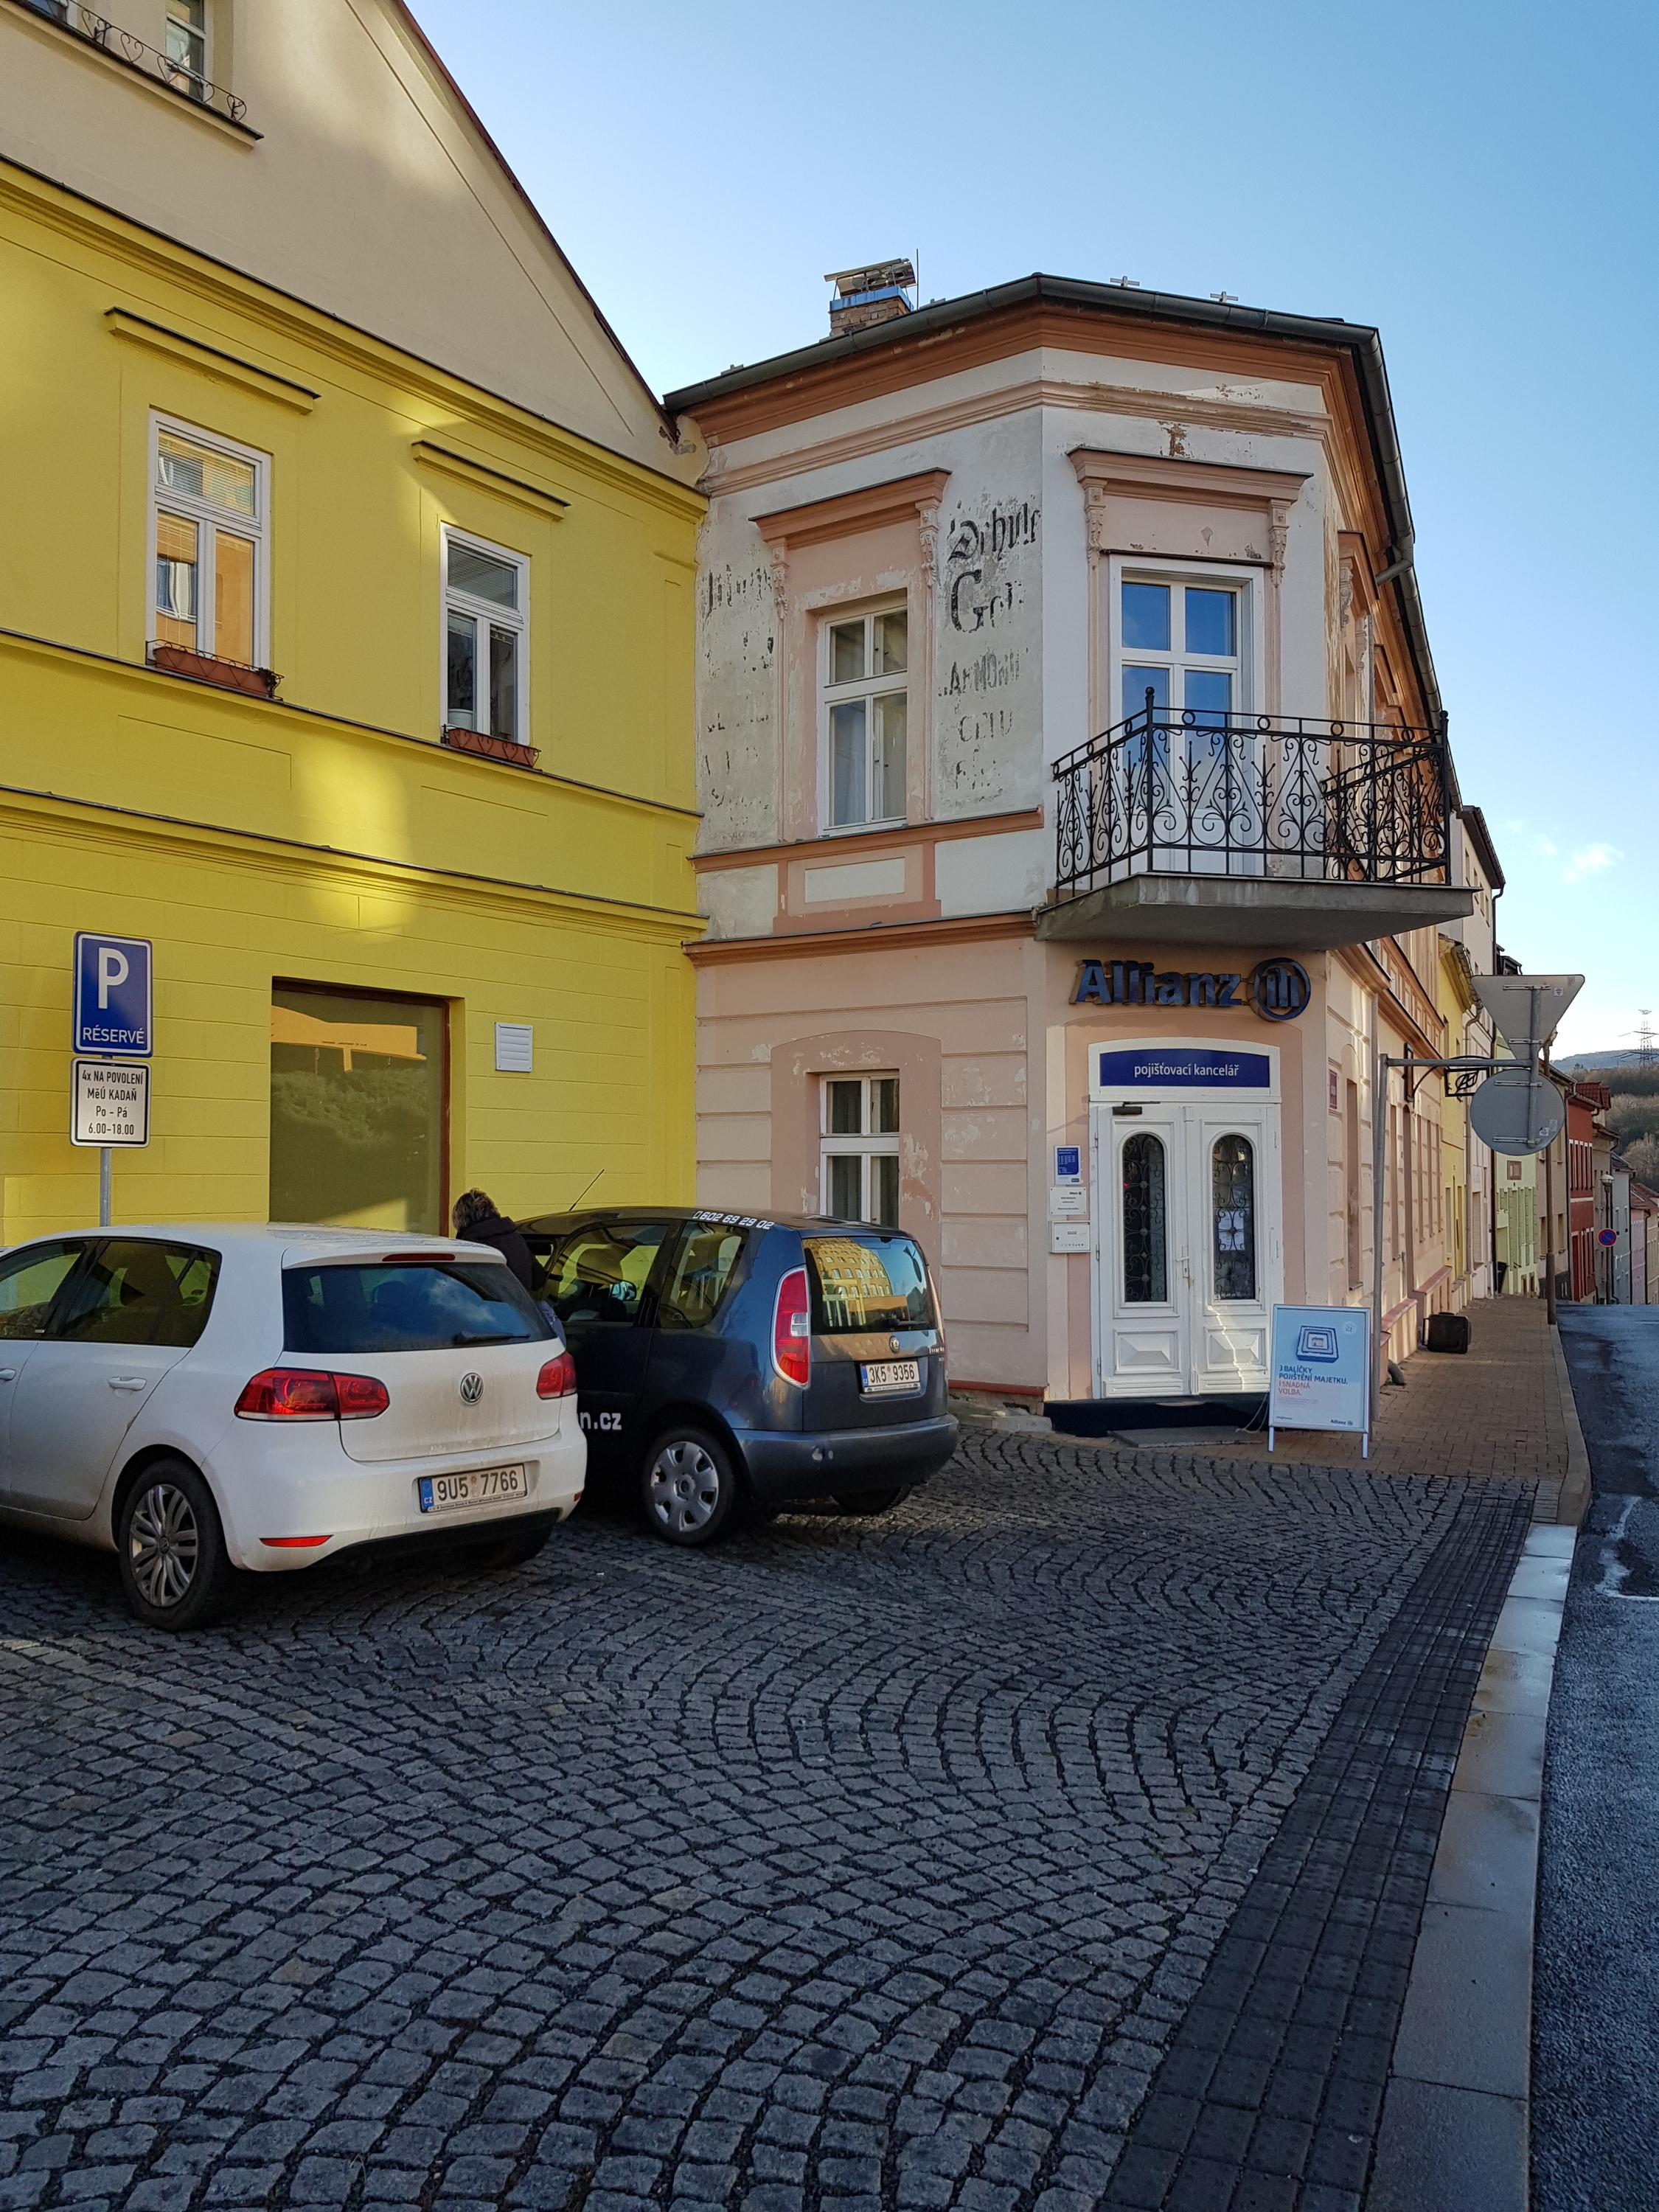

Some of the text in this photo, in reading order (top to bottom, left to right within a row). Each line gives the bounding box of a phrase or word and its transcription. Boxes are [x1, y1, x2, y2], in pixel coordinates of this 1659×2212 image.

[97, 947, 129, 1009] P
[1071, 959, 1242, 1006] Allianz
[83, 1025, 145, 1045] RÉSERVÉ
[82, 1069, 144, 1085] 4x NA POVOLENÍ
[1134, 1062, 1239, 1078] pojišťovací kancelář
[87, 1086, 137, 1102] MěÚ KADAŇ
[96, 1105, 106, 1117] Po
[117, 1106, 128, 1118] Pá
[88, 1122, 135, 1135] 6.00-18.00
[692, 1210, 775, 1230] 0602 69 29 02
[869, 1363, 915, 1383] 3K5 9356
[1314, 1376, 1349, 1385] MAJETKU.
[437, 1476, 469, 1502] 9U5
[481, 1470, 518, 1496] 7766
[424, 1497, 434, 1505] CZ
